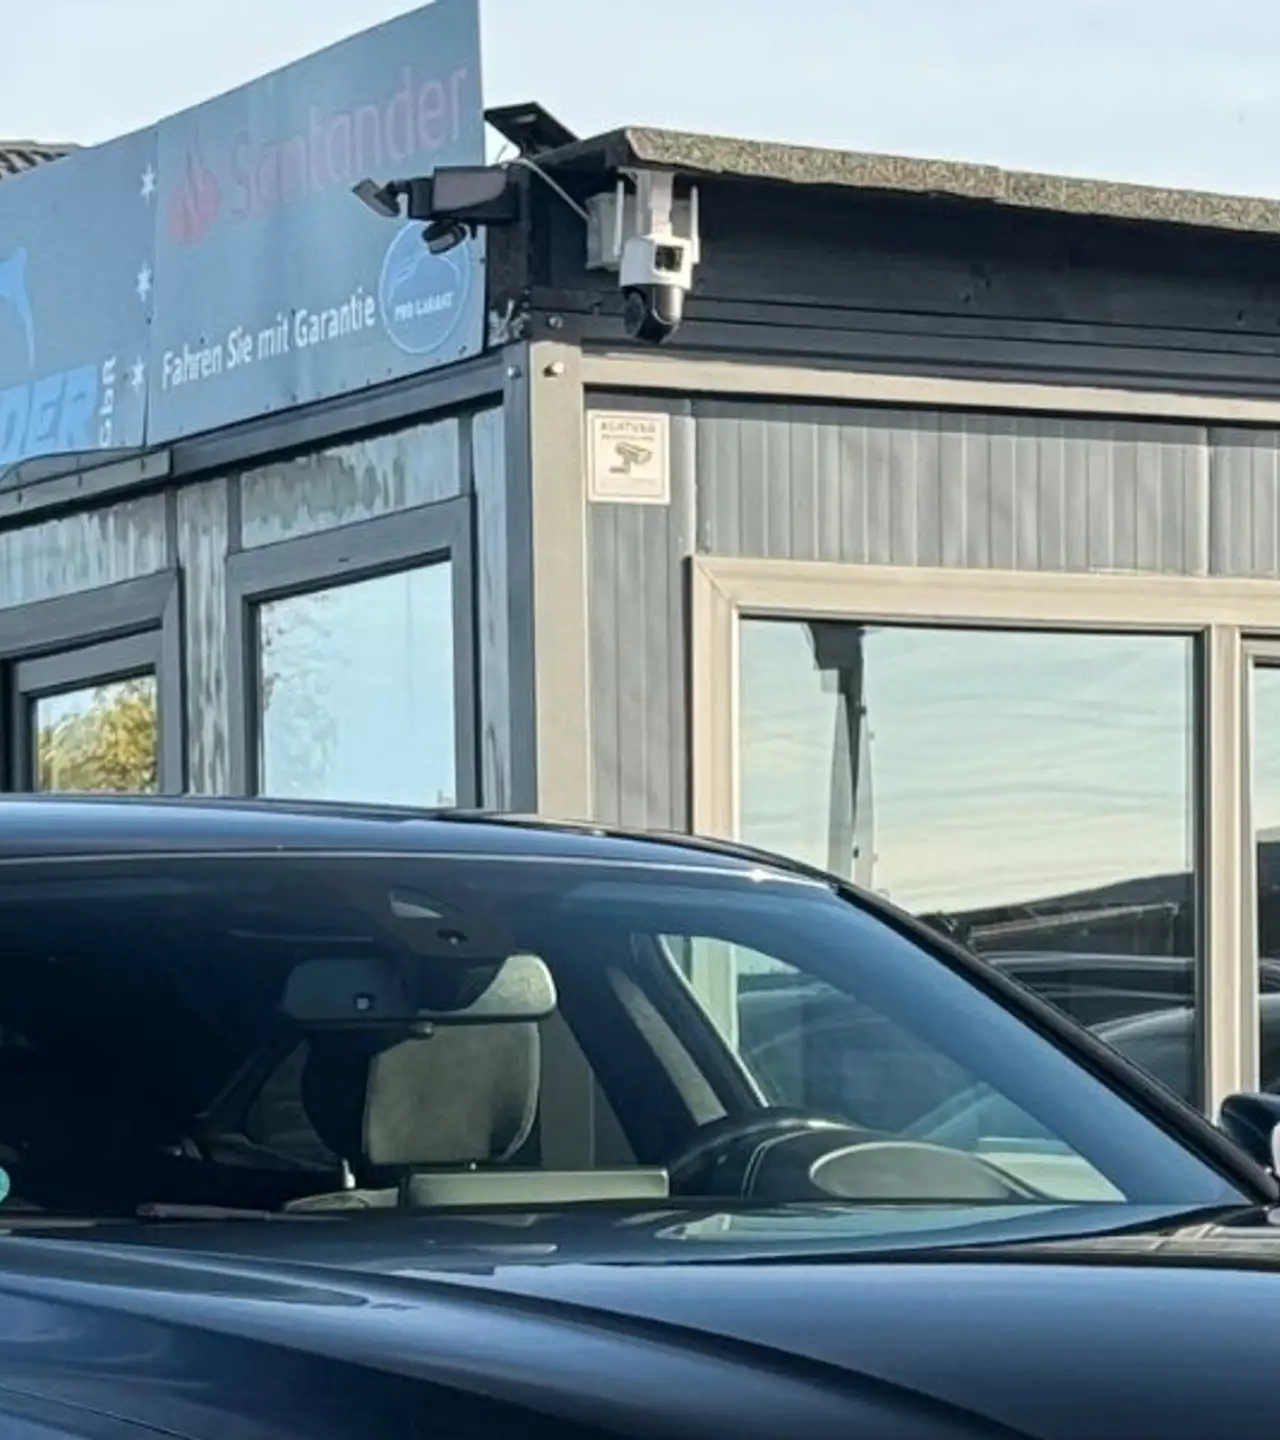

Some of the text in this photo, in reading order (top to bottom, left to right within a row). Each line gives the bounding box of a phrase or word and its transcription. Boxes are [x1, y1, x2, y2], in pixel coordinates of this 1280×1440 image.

[227, 64, 468, 218] Santander
[162, 287, 375, 391] Fahren Sie mit Garantie
